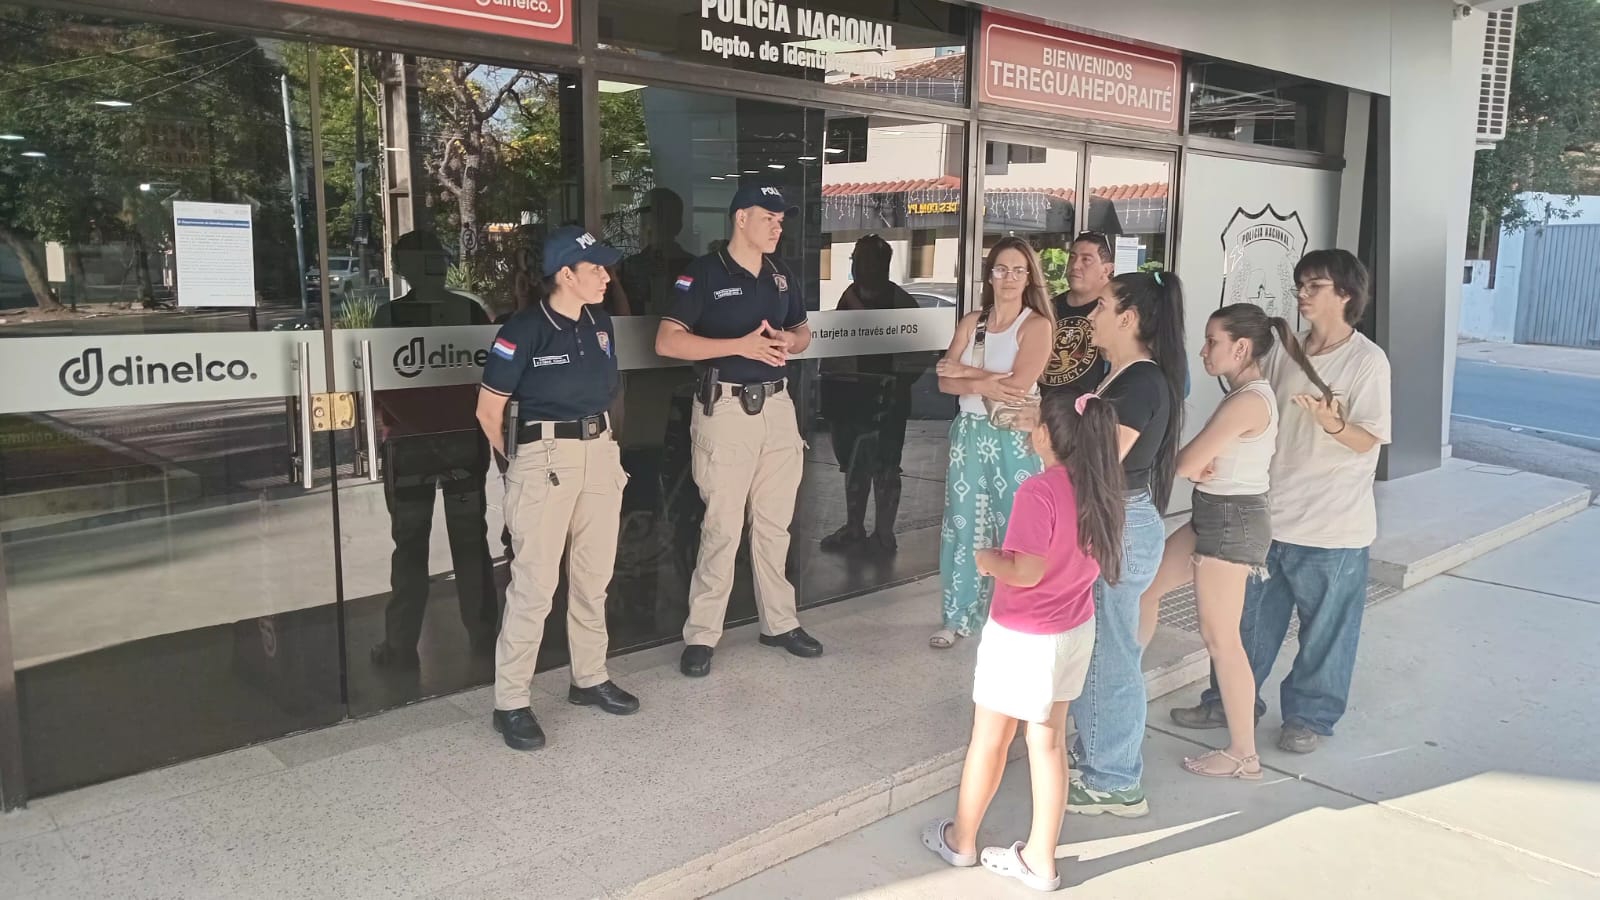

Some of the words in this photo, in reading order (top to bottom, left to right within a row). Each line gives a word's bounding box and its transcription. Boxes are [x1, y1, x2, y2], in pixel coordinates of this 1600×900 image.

[701, 29, 755, 59] Depto.
[759, 41, 779, 62] de
[797, 8, 897, 50] NACIONAL
[1043, 47, 1133, 81] BIENVENIDOS
[990, 60, 1172, 112] TEREGUAHEPORAITÉ
[820, 328, 848, 340] tarjeta
[850, 329, 856, 337] a
[858, 326, 884, 337] través
[886, 325, 899, 335] del
[900, 323, 918, 334] POS
[107, 352, 258, 387] dinelco.
[1049, 367, 1079, 384] MERCY
